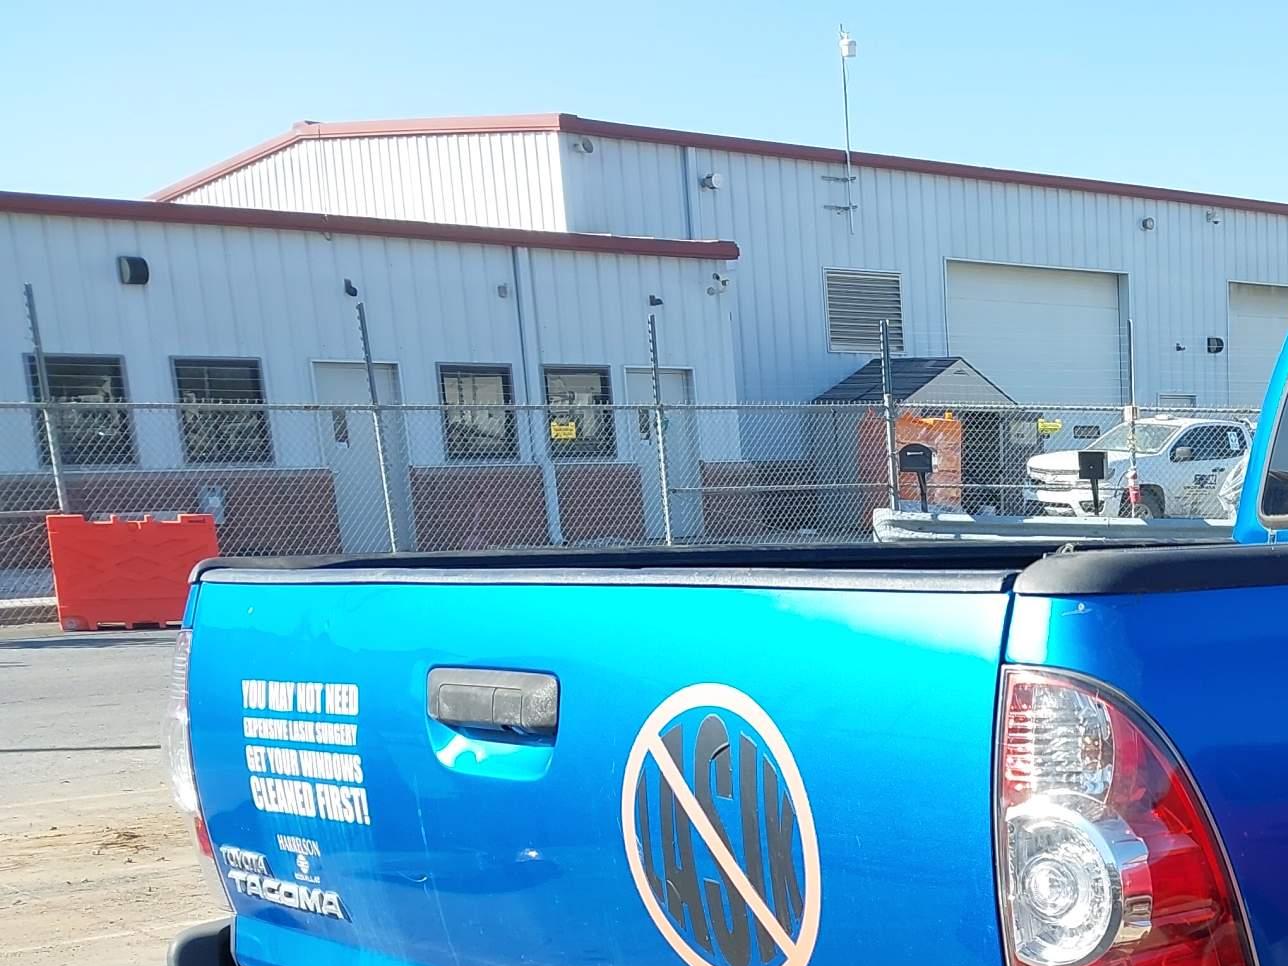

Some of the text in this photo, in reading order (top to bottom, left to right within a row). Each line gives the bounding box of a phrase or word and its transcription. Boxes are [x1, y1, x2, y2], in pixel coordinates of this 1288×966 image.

[241, 679, 359, 716] YOU MAY NOT NEED
[243, 717, 358, 746] EXPENSIVE LASIK SURGERY
[245, 745, 363, 784] GET YOUR WINDOWS
[250, 775, 371, 825] CLEANED FIRST!
[219, 844, 268, 875] TOYOTA
[228, 868, 345, 920] TACOMA
